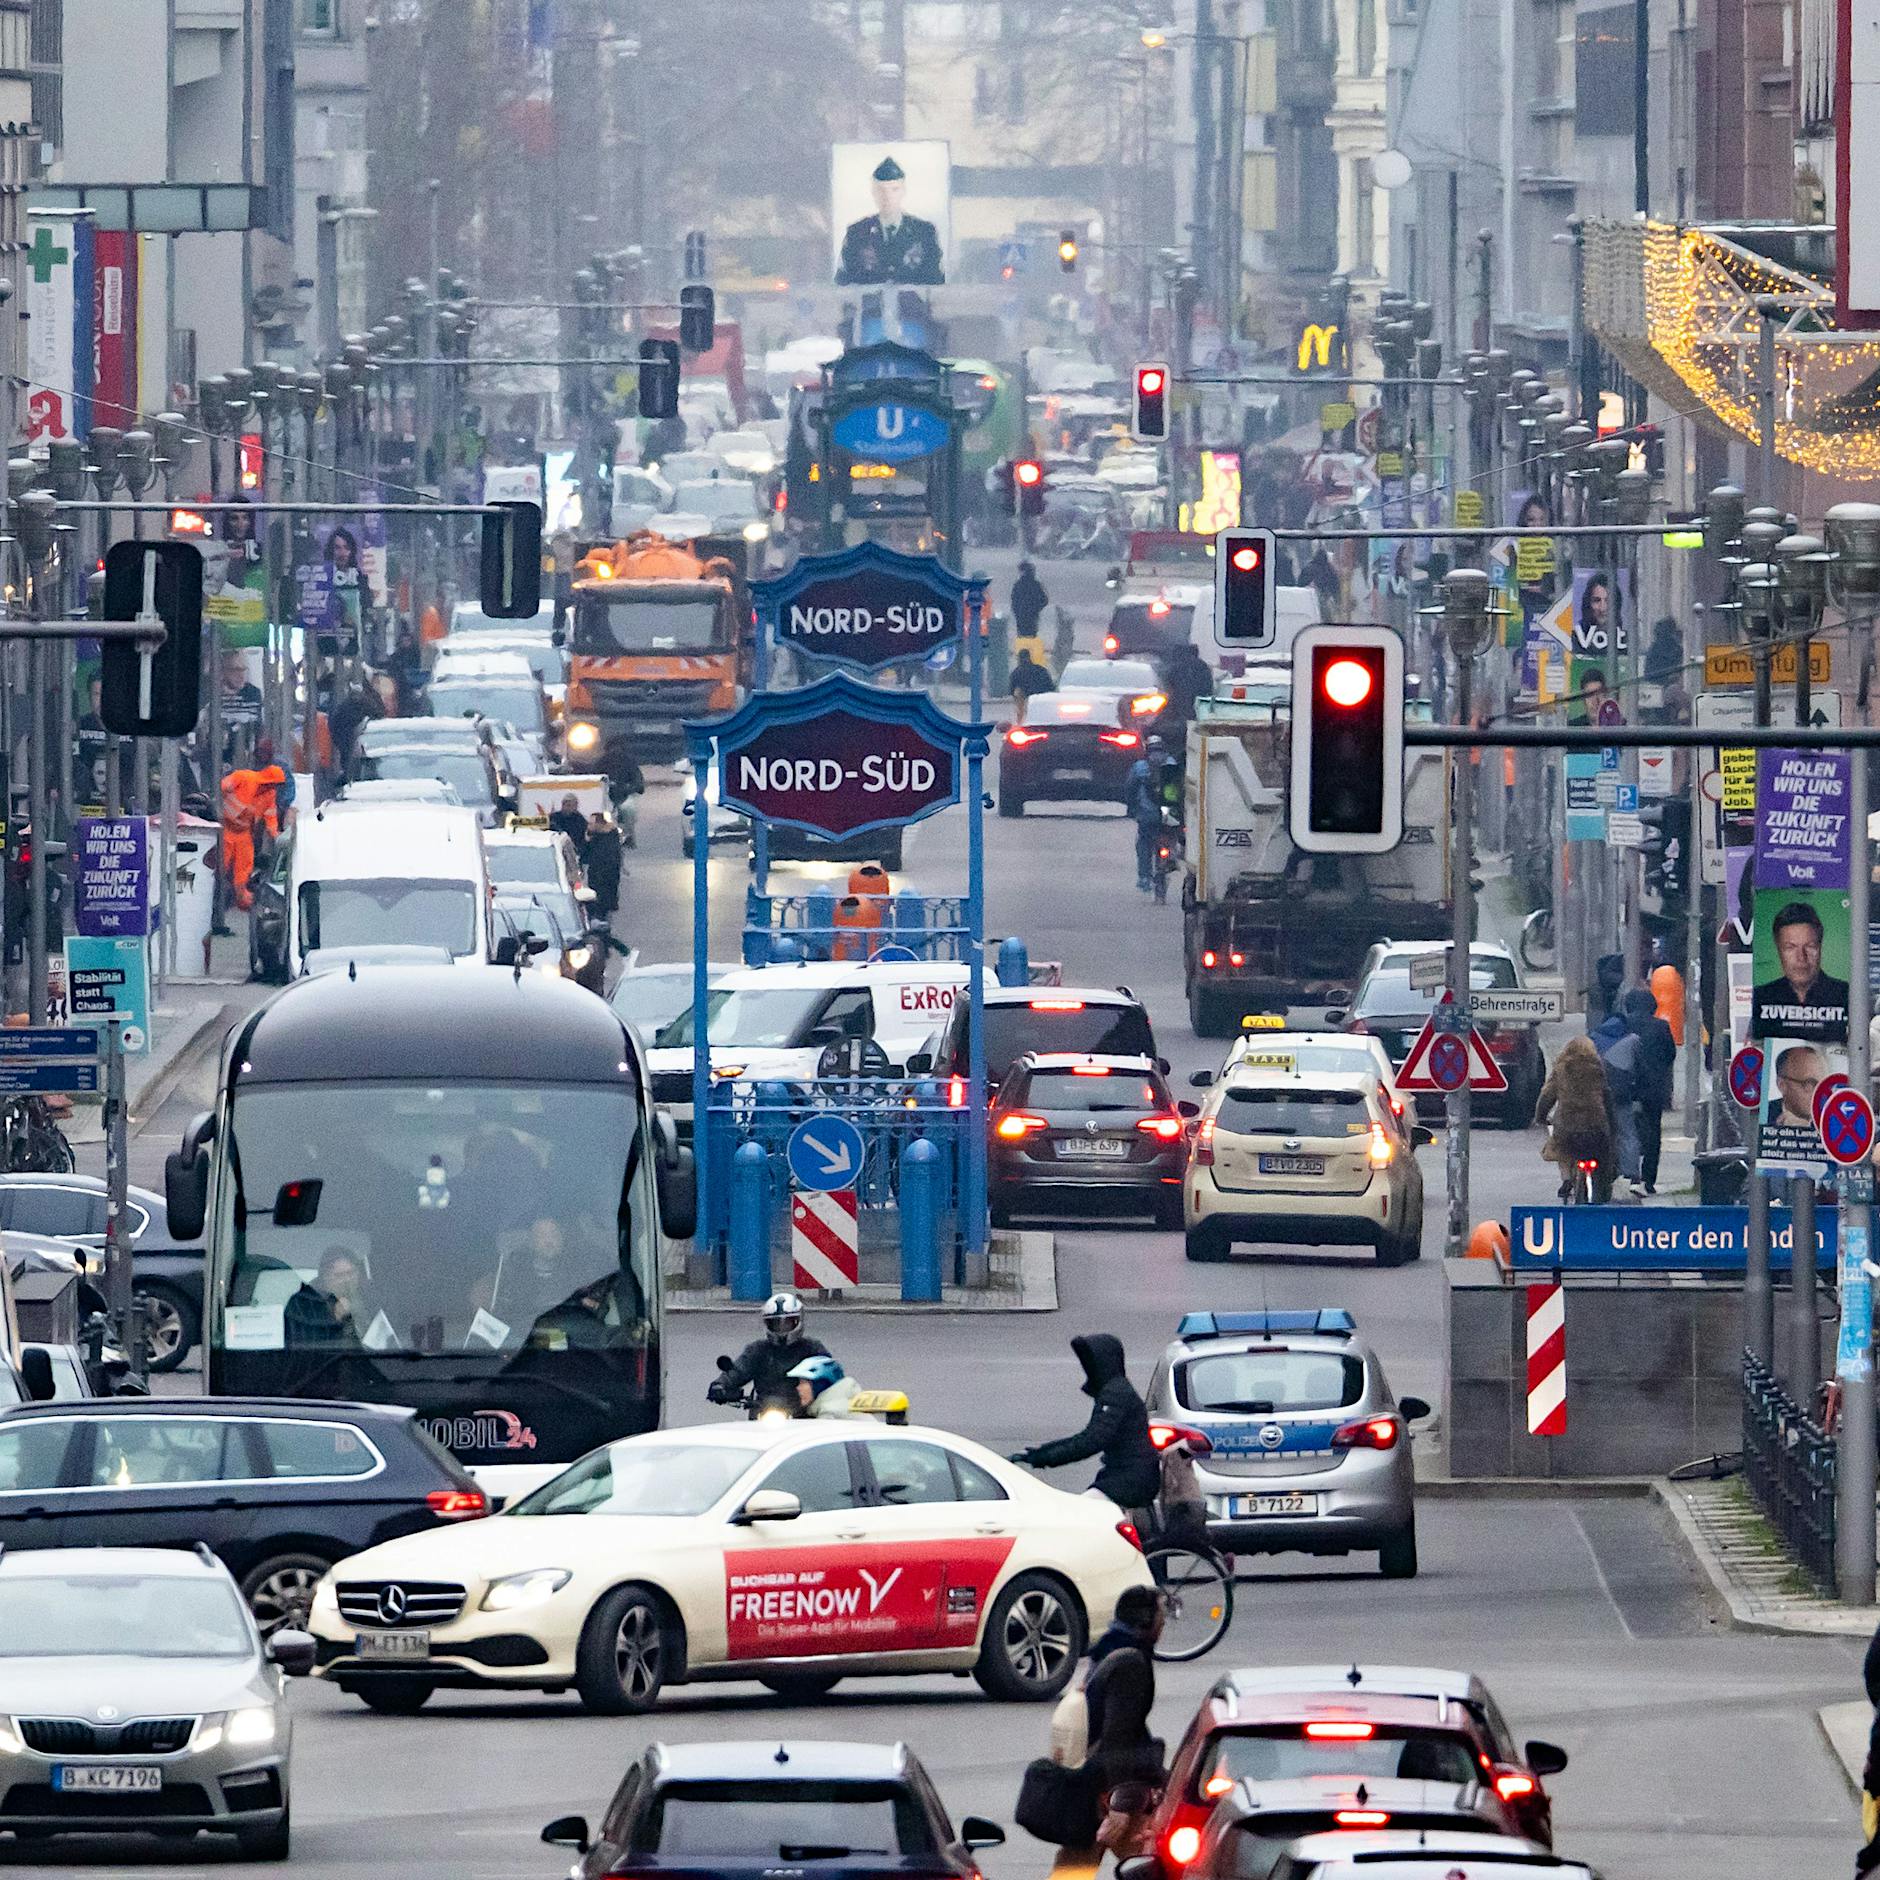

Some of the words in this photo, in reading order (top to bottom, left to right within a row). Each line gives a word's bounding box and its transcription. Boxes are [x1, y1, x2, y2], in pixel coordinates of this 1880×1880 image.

[789, 601, 944, 635] NORD-SÜD
[1575, 624, 1628, 650] Vot
[739, 752, 936, 793] NORD-SÜD
[1781, 760, 1837, 778] HOLEN
[1773, 777, 1807, 794] WIR
[1809, 779, 1843, 796] UNS
[1792, 795, 1821, 812] DIE
[1765, 812, 1846, 831] ZUKUNFT
[90, 825, 131, 839] HOLEN
[86, 839, 108, 854] WIR
[110, 839, 137, 854] UNS
[98, 854, 120, 870] DIE
[83, 869, 141, 885] ZUKUNFT
[1788, 864, 1815, 880] Volt
[74, 972, 122, 984] Stabilität
[75, 988, 101, 998] statt
[1470, 996, 1556, 1015] Behrenstraße
[1760, 1004, 1849, 1022] ZUVERSICHT.
[1250, 1018, 1278, 1027] TAXI
[1762, 1126, 1779, 1137] Für
[1779, 1128, 1795, 1137] ein
[1762, 1139, 1779, 1147] auf
[1780, 1139, 1798, 1148] das
[1761, 1149, 1785, 1158] stolz
[1523, 1216, 1554, 1256] U
[1611, 1224, 1681, 1250] Unter
[1688, 1224, 1734, 1250] den
[1214, 1435, 1260, 1447] POLIZE
[1267, 1497, 1304, 1512] 7122
[798, 1571, 826, 1584] AUF
[115, 1769, 159, 1787] 7196
